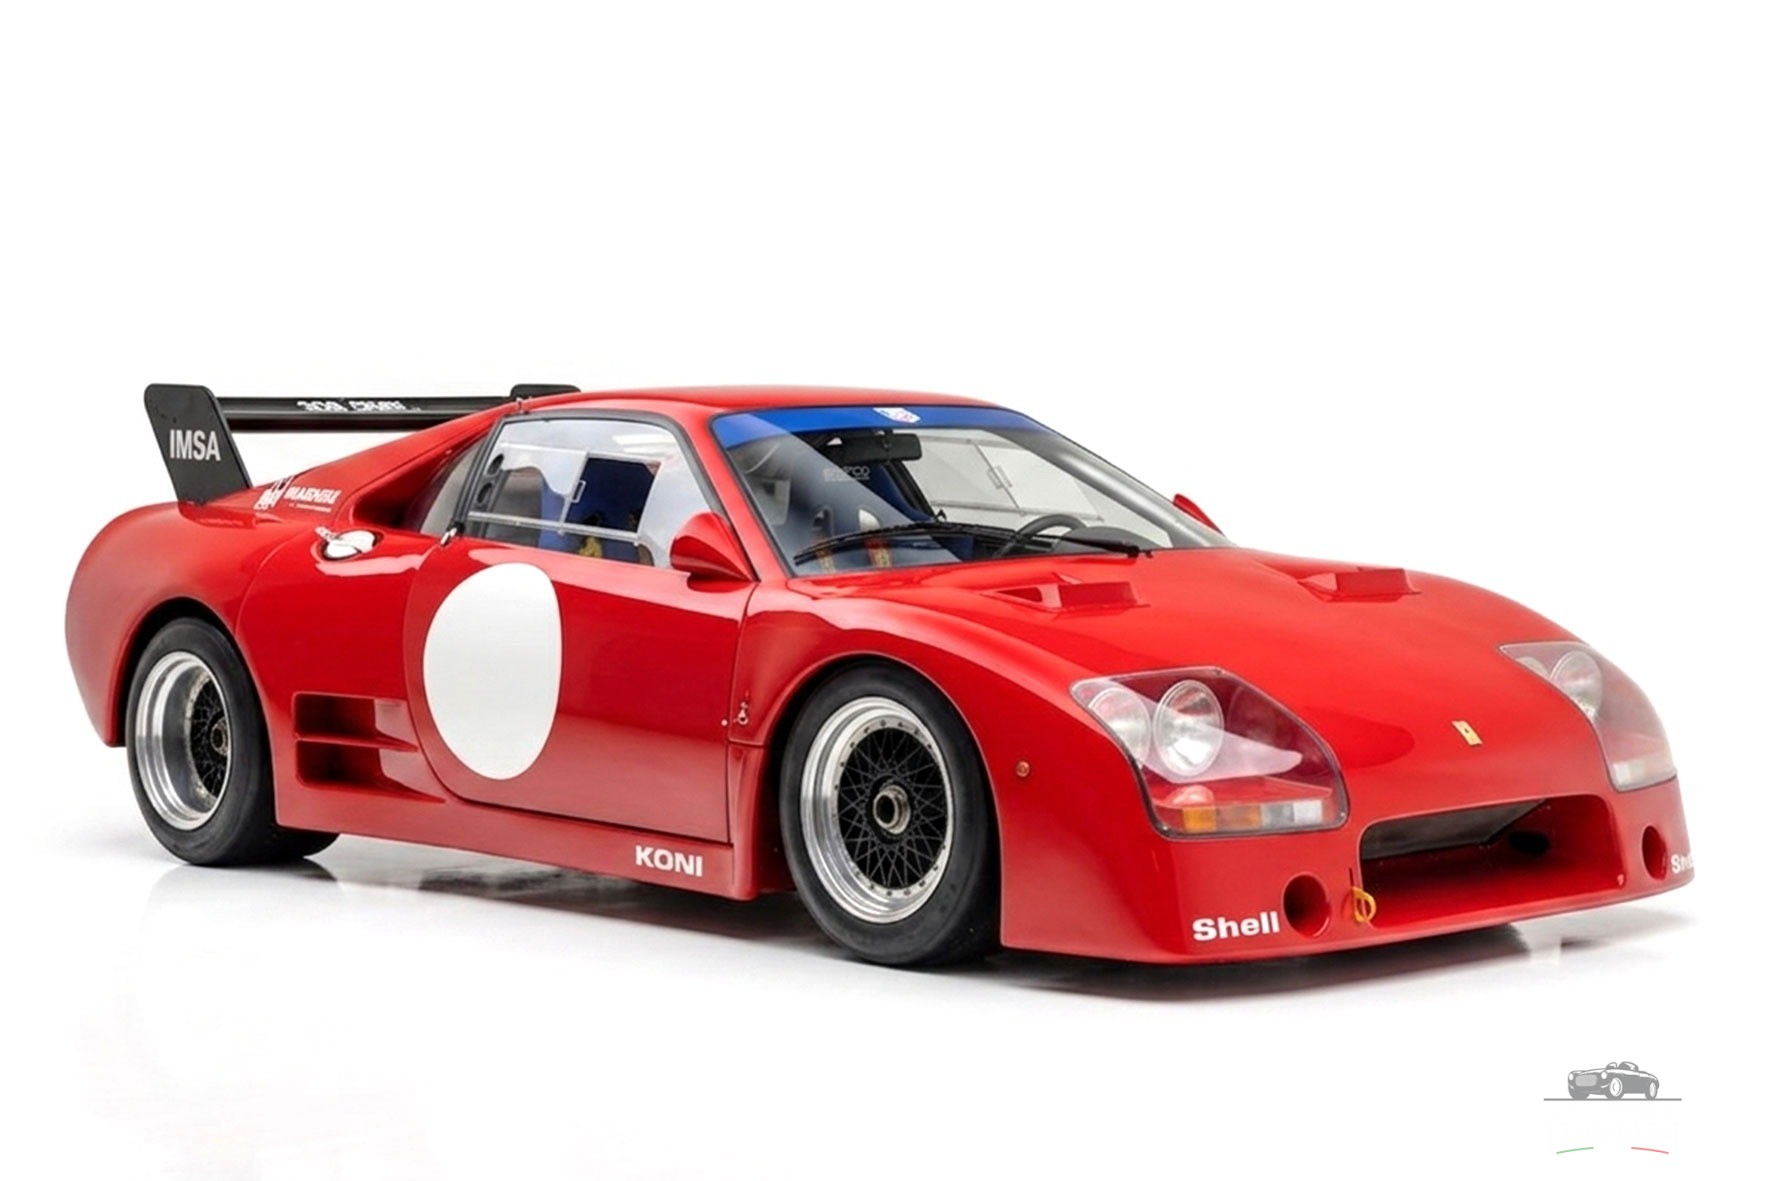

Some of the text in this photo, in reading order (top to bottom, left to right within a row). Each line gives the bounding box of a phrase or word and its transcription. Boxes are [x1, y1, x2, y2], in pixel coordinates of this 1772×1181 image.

[169, 429, 221, 461] IMSA
[635, 845, 703, 877] KONI
[1192, 911, 1280, 941] Shell
